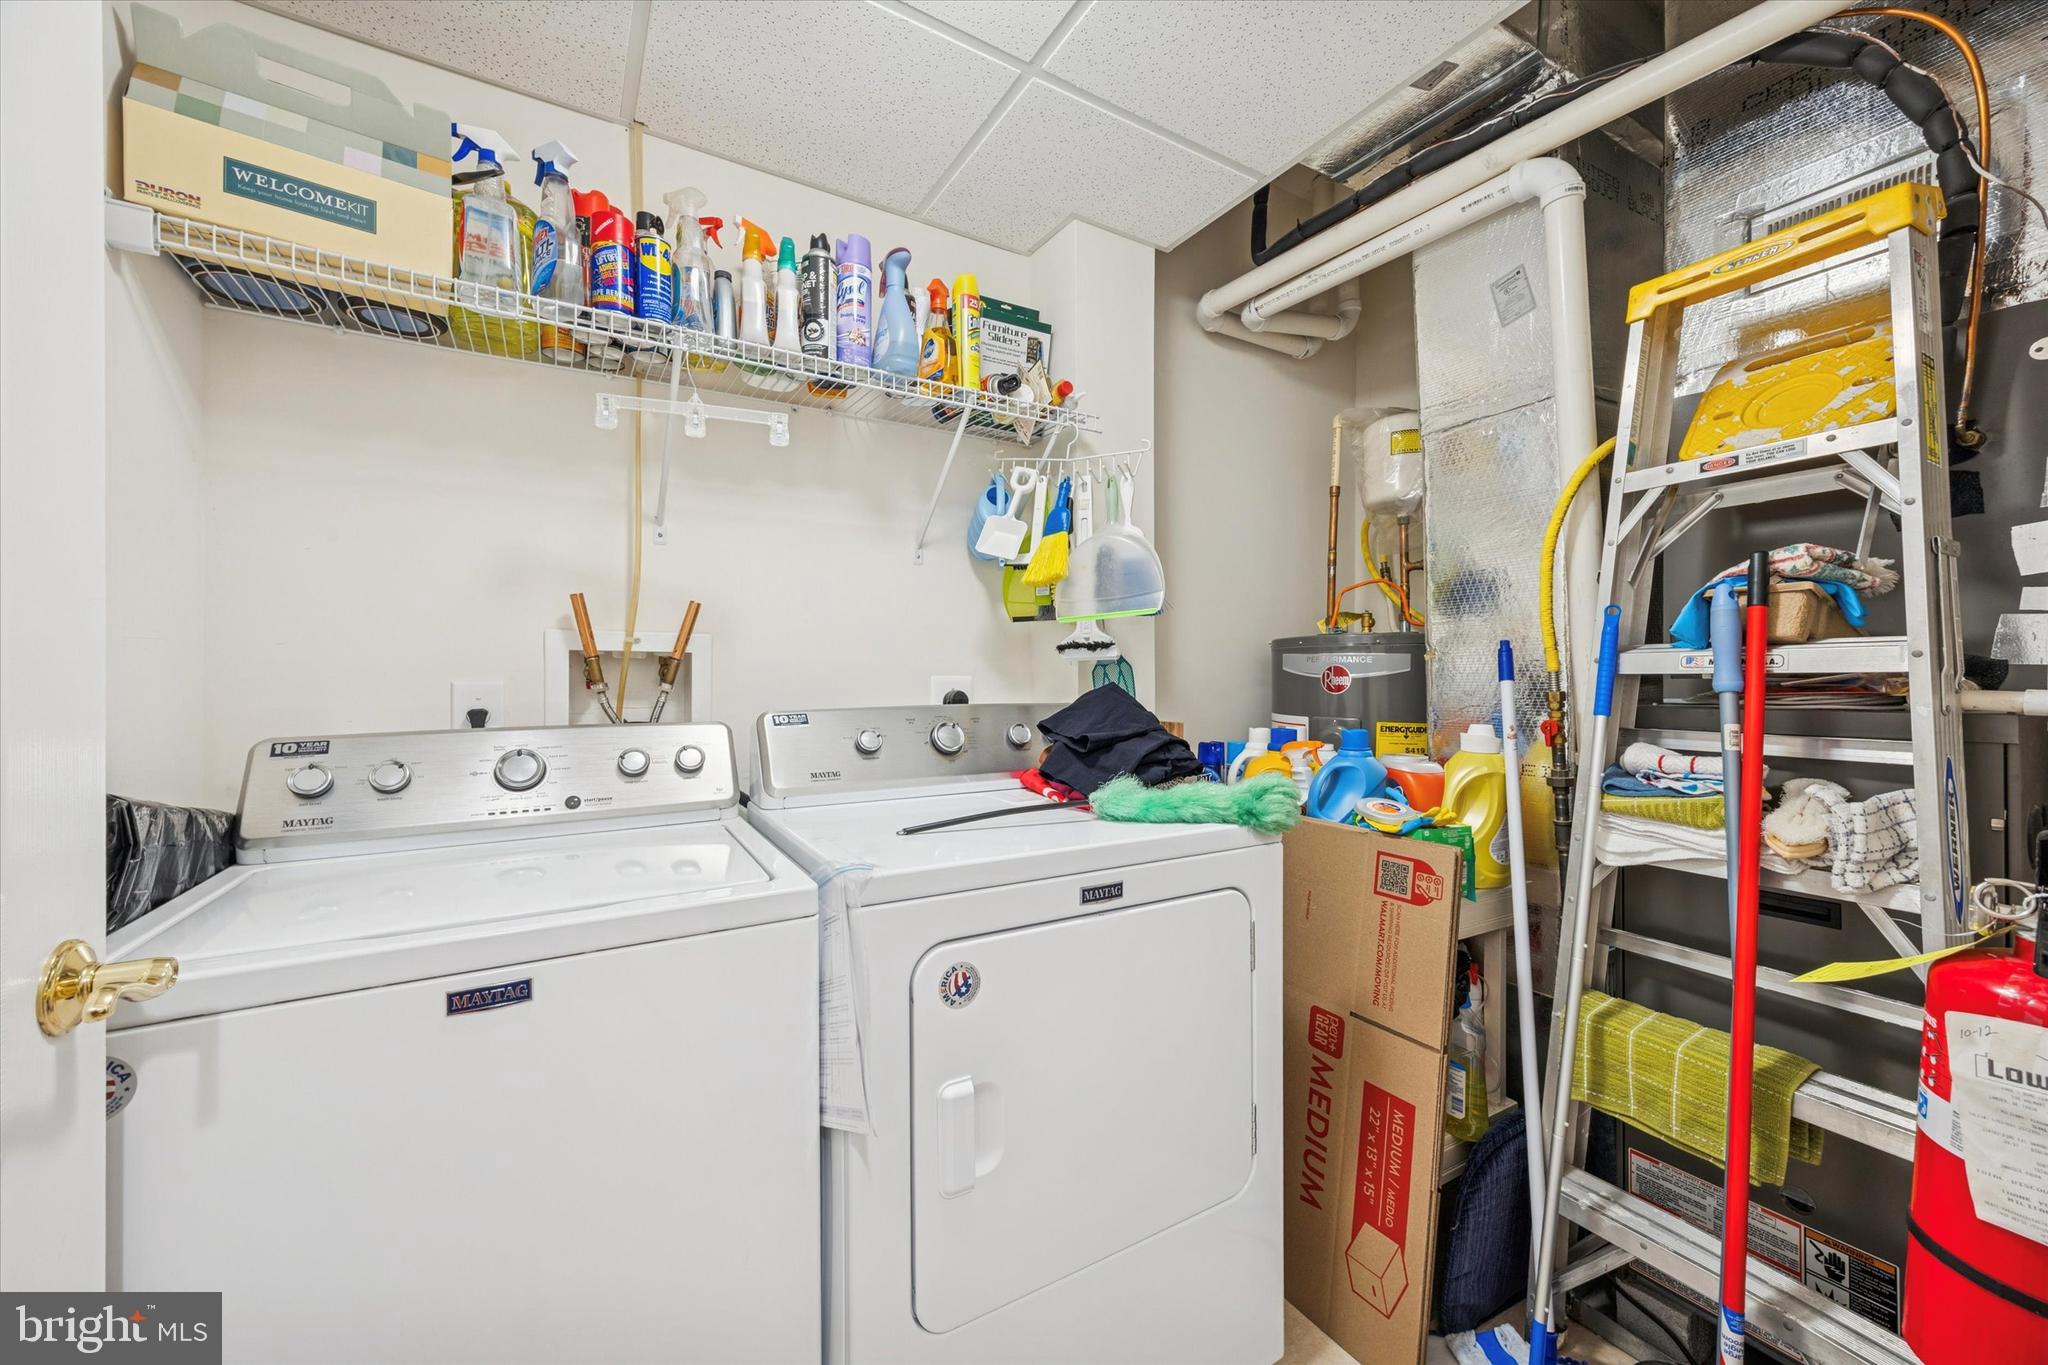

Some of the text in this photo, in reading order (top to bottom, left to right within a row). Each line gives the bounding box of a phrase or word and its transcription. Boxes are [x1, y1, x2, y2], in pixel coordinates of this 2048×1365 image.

[982, 320, 1028, 339] Furniture
[987, 331, 1021, 347] Sliders
[1306, 655, 1374, 664] PERFORMANCE
[1324, 666, 1350, 689] Rheem
[774, 715, 789, 724] 10
[273, 742, 298, 755] 10
[810, 770, 841, 780] MAYTAG
[282, 816, 334, 829] MAYTAG
[1083, 885, 1121, 901] MAYTAG
[1373, 900, 1388, 1007] WALMART.COM/MOVING
[451, 983, 529, 1011] MAYTAG
[1314, 1013, 1328, 1047] GEAR
[1369, 1106, 1381, 1134] 22"
[1299, 1052, 1335, 1212] MEDIUM
[1389, 1108, 1405, 1177] MEDIUM
[1366, 1145, 1378, 1169] 13"
[1363, 1180, 1375, 1205] 15"
[1385, 1188, 1396, 1228] MEDIO
